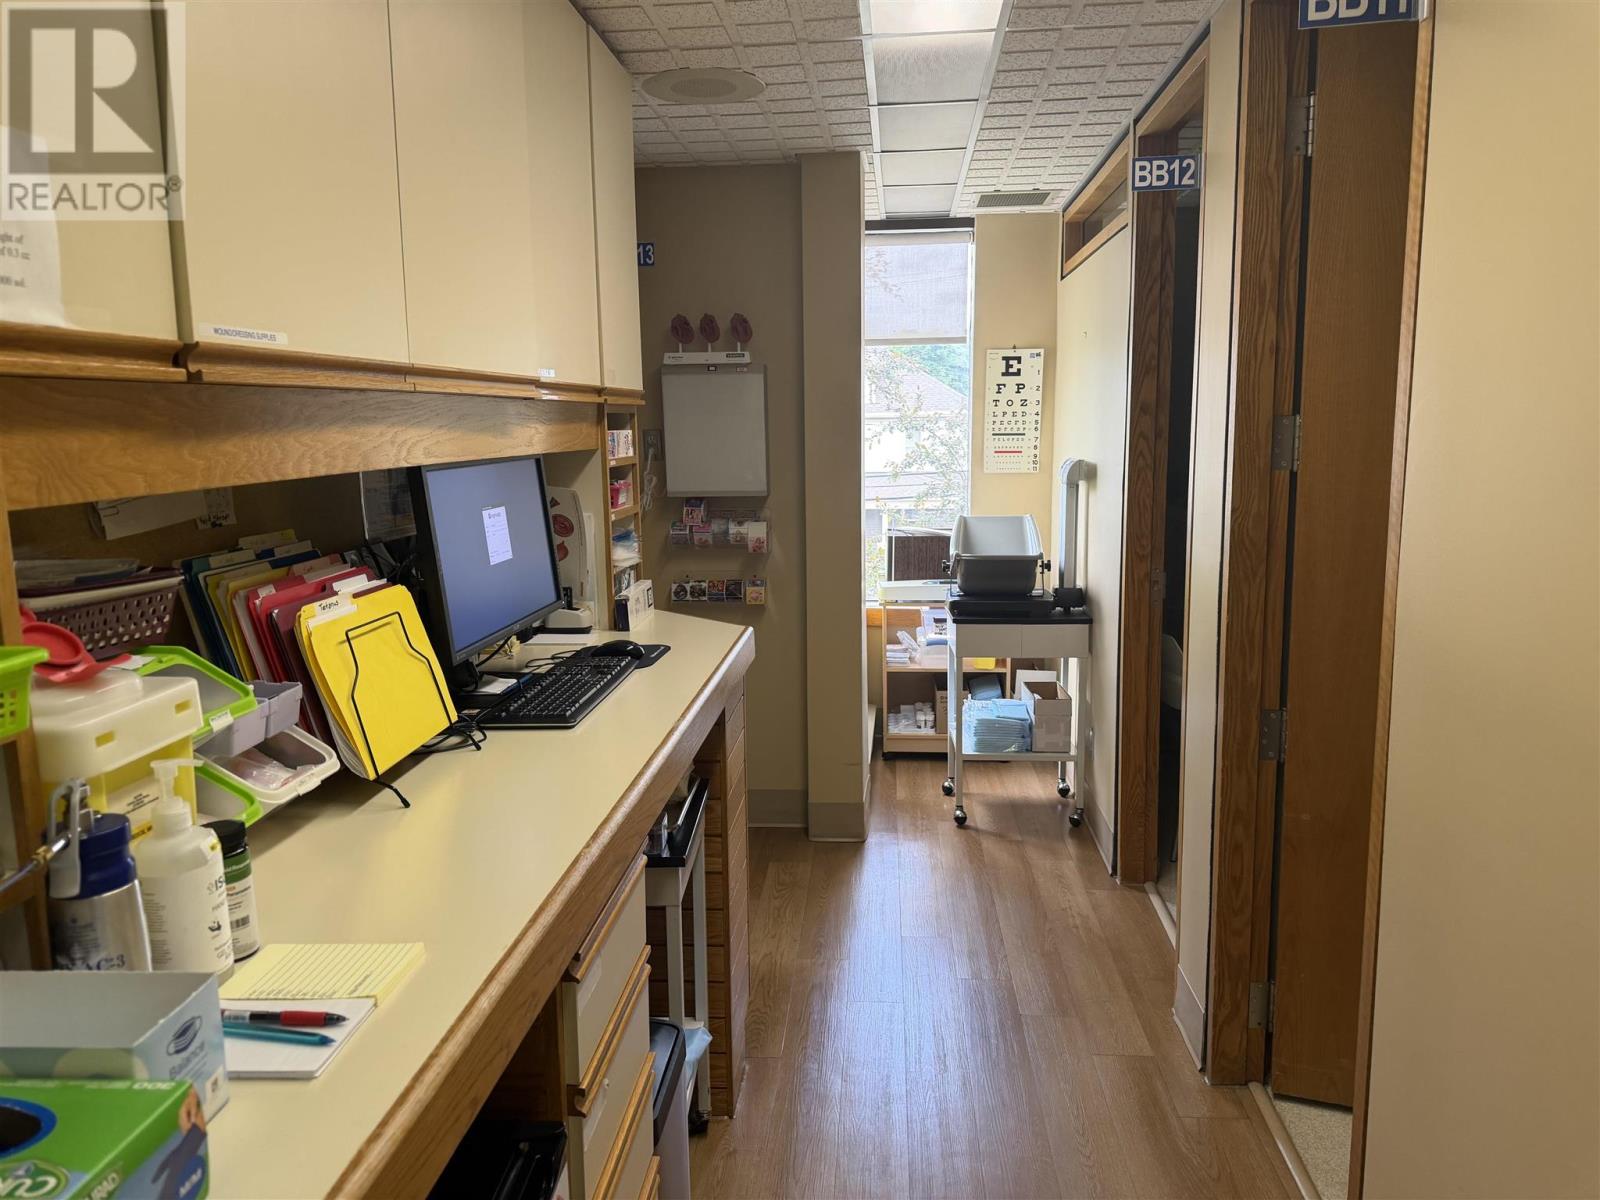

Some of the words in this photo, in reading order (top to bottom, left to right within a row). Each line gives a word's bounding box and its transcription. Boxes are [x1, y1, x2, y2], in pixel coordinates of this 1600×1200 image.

[1134, 158, 1196, 188] BB12
[638, 244, 654, 265] 13
[1001, 356, 1022, 377] E
[995, 383, 1007, 394] F
[1014, 383, 1026, 394] P
